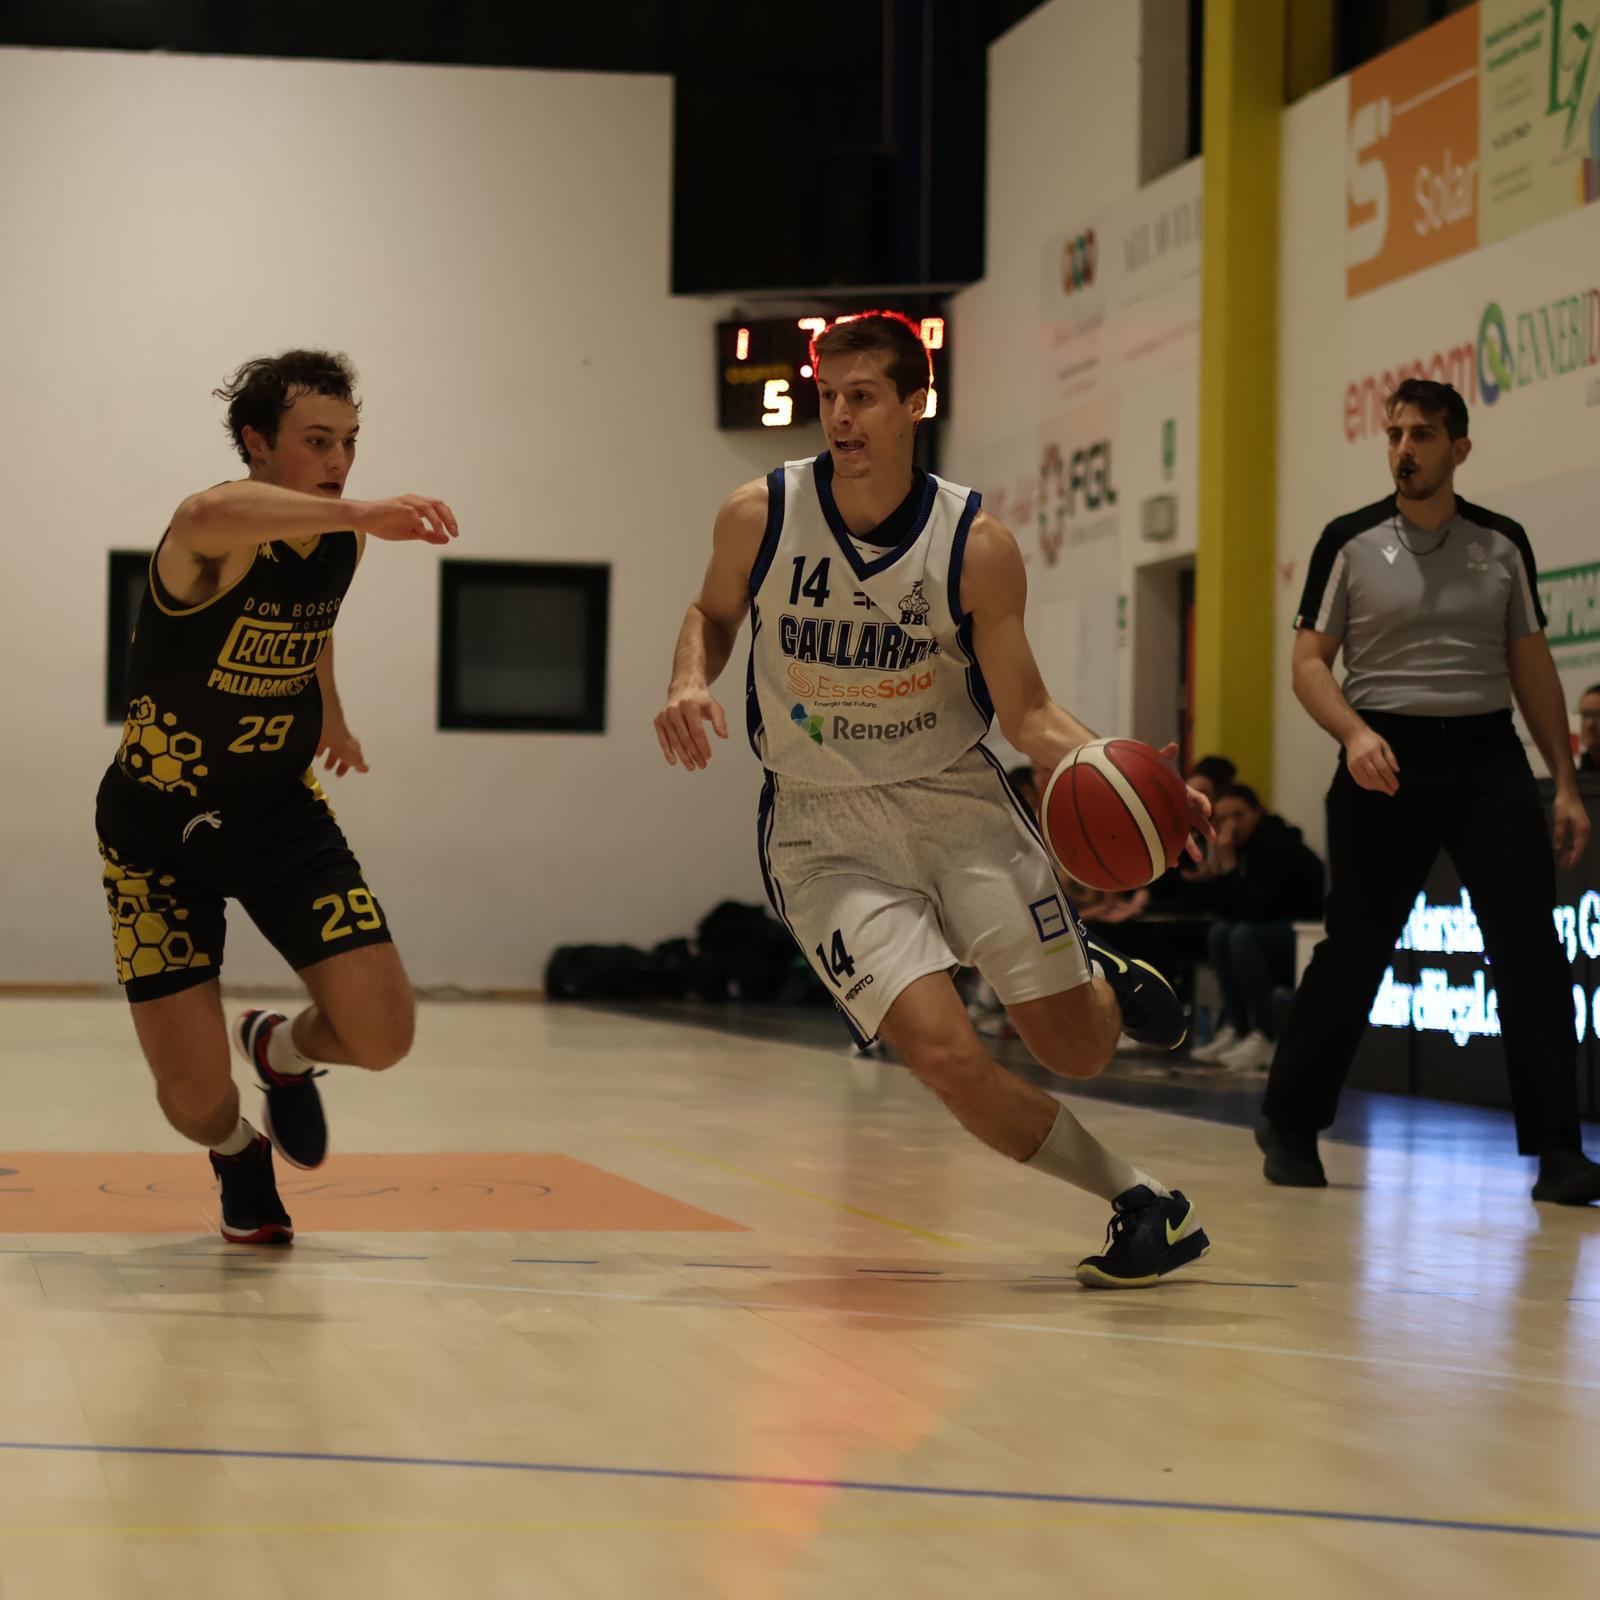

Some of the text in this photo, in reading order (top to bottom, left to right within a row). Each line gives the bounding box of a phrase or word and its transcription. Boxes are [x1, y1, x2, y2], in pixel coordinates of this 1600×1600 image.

[762, 379, 793, 426] 5
[789, 556, 831, 608] 14
[243, 597, 281, 617] DON
[227, 714, 295, 754] 29
[833, 711, 938, 741] Renexia
[312, 887, 382, 943] 29
[816, 928, 855, 989] 14
